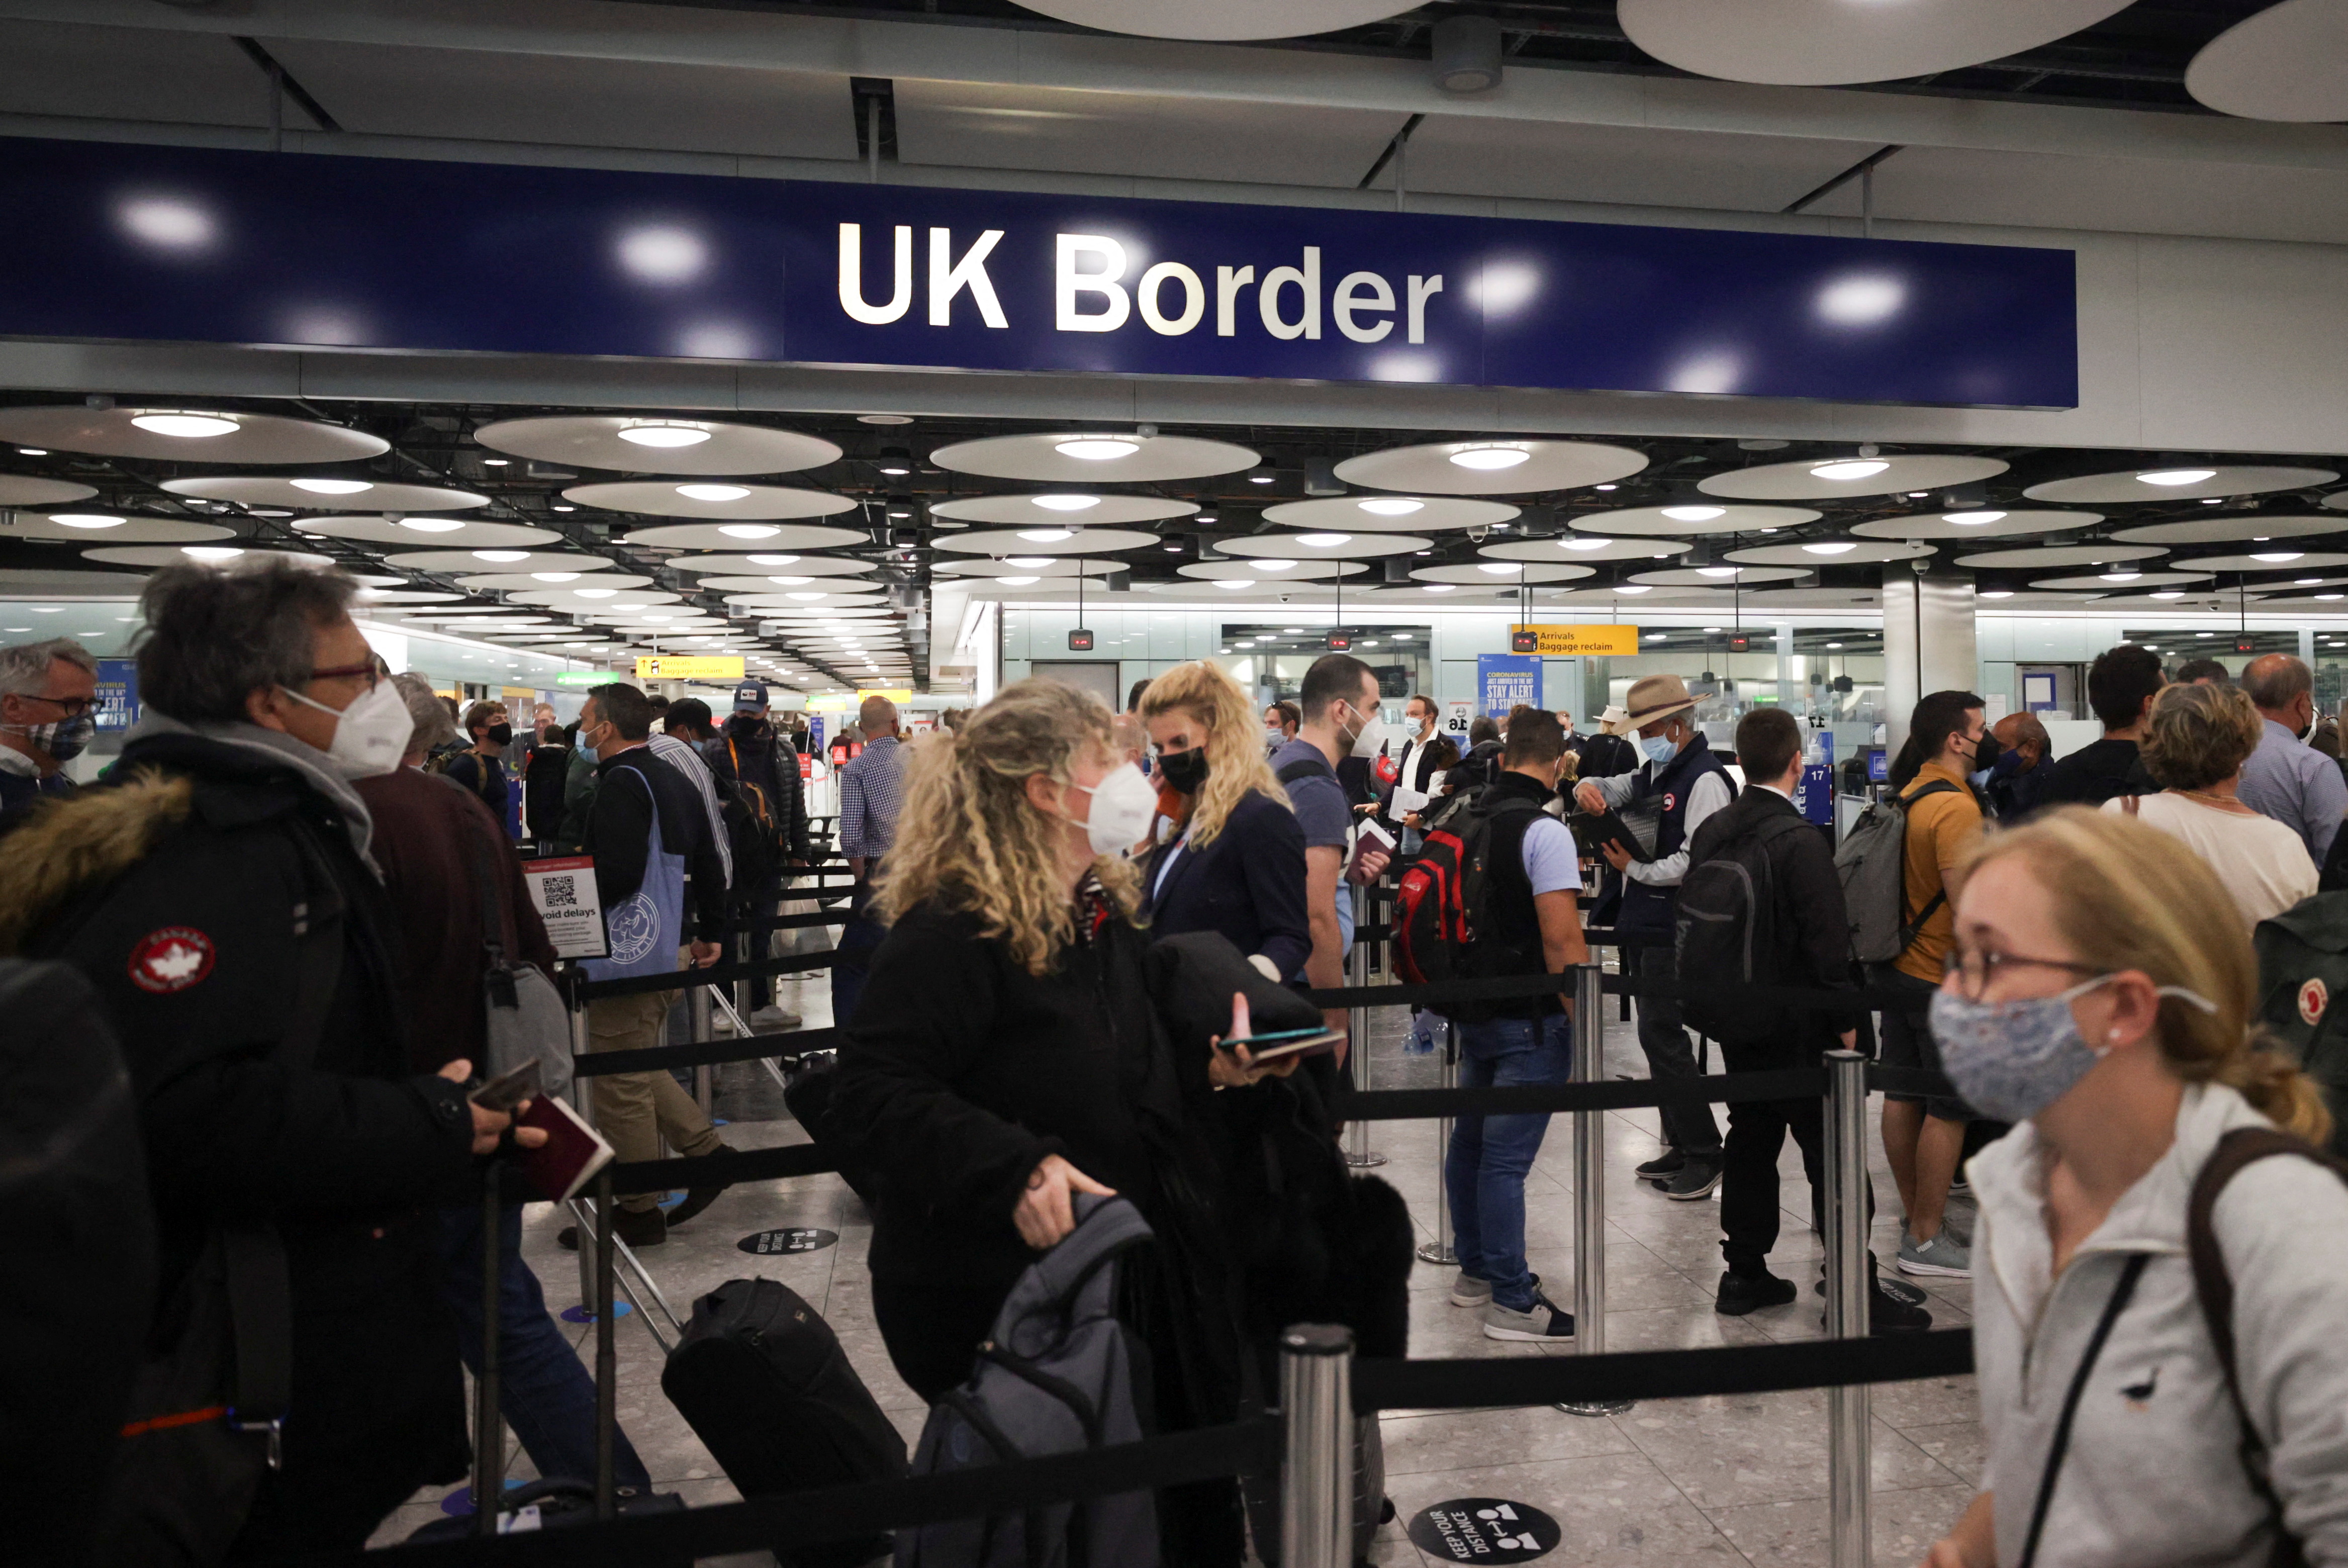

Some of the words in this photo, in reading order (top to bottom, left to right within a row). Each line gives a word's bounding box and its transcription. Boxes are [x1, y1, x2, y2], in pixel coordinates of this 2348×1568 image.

[838, 223, 1009, 329] UK
[1056, 233, 1443, 344] Border
[1540, 632, 1575, 640] Arrivals
[1540, 643, 1578, 652] Baggage
[1581, 642, 1613, 651] reclaim
[1487, 685, 1507, 698] STAY
[1509, 685, 1534, 698] ALERT
[1487, 699, 1497, 710] TO
[1812, 771, 1824, 780] 17
[541, 910, 561, 919] void
[563, 908, 596, 918] delays
[760, 1233, 771, 1244] YOUR
[771, 1233, 784, 1251] DISTANCE
[757, 1244, 768, 1253] KEEP
[1429, 1510, 1456, 1536] YOUR
[1450, 1511, 1491, 1554] DISTANCE
[1446, 1536, 1472, 1558] KEEP
